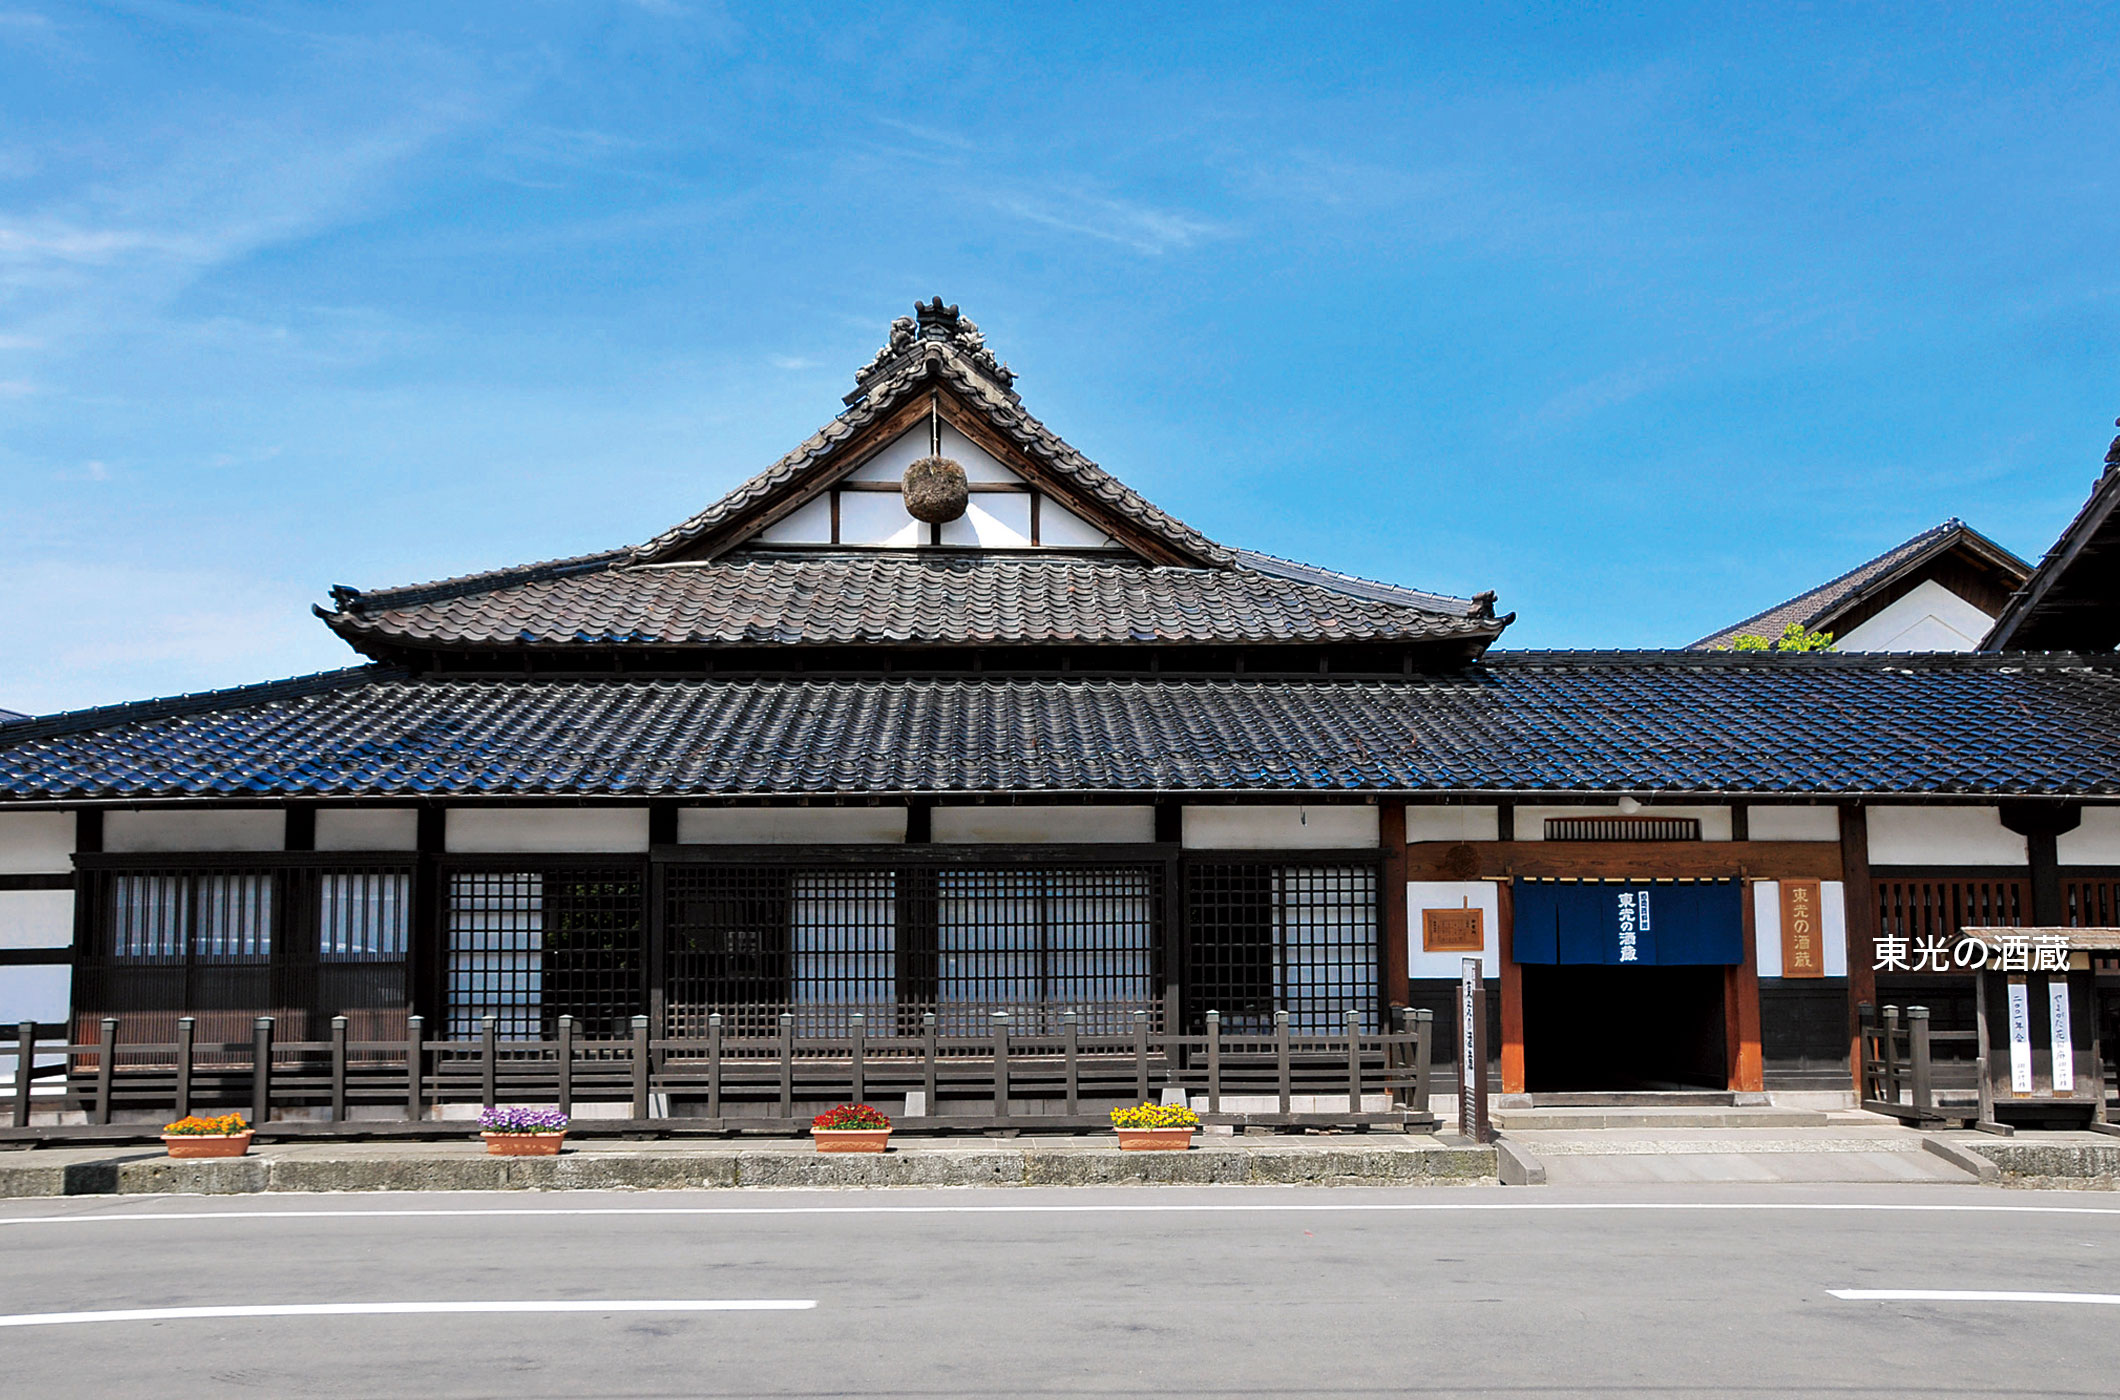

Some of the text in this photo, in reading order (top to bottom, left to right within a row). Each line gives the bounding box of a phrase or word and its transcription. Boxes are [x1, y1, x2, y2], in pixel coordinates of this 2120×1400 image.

[1617, 892, 1638, 962] 東光の酒蔵
[1792, 887, 1813, 968] 東光の酒蔵
